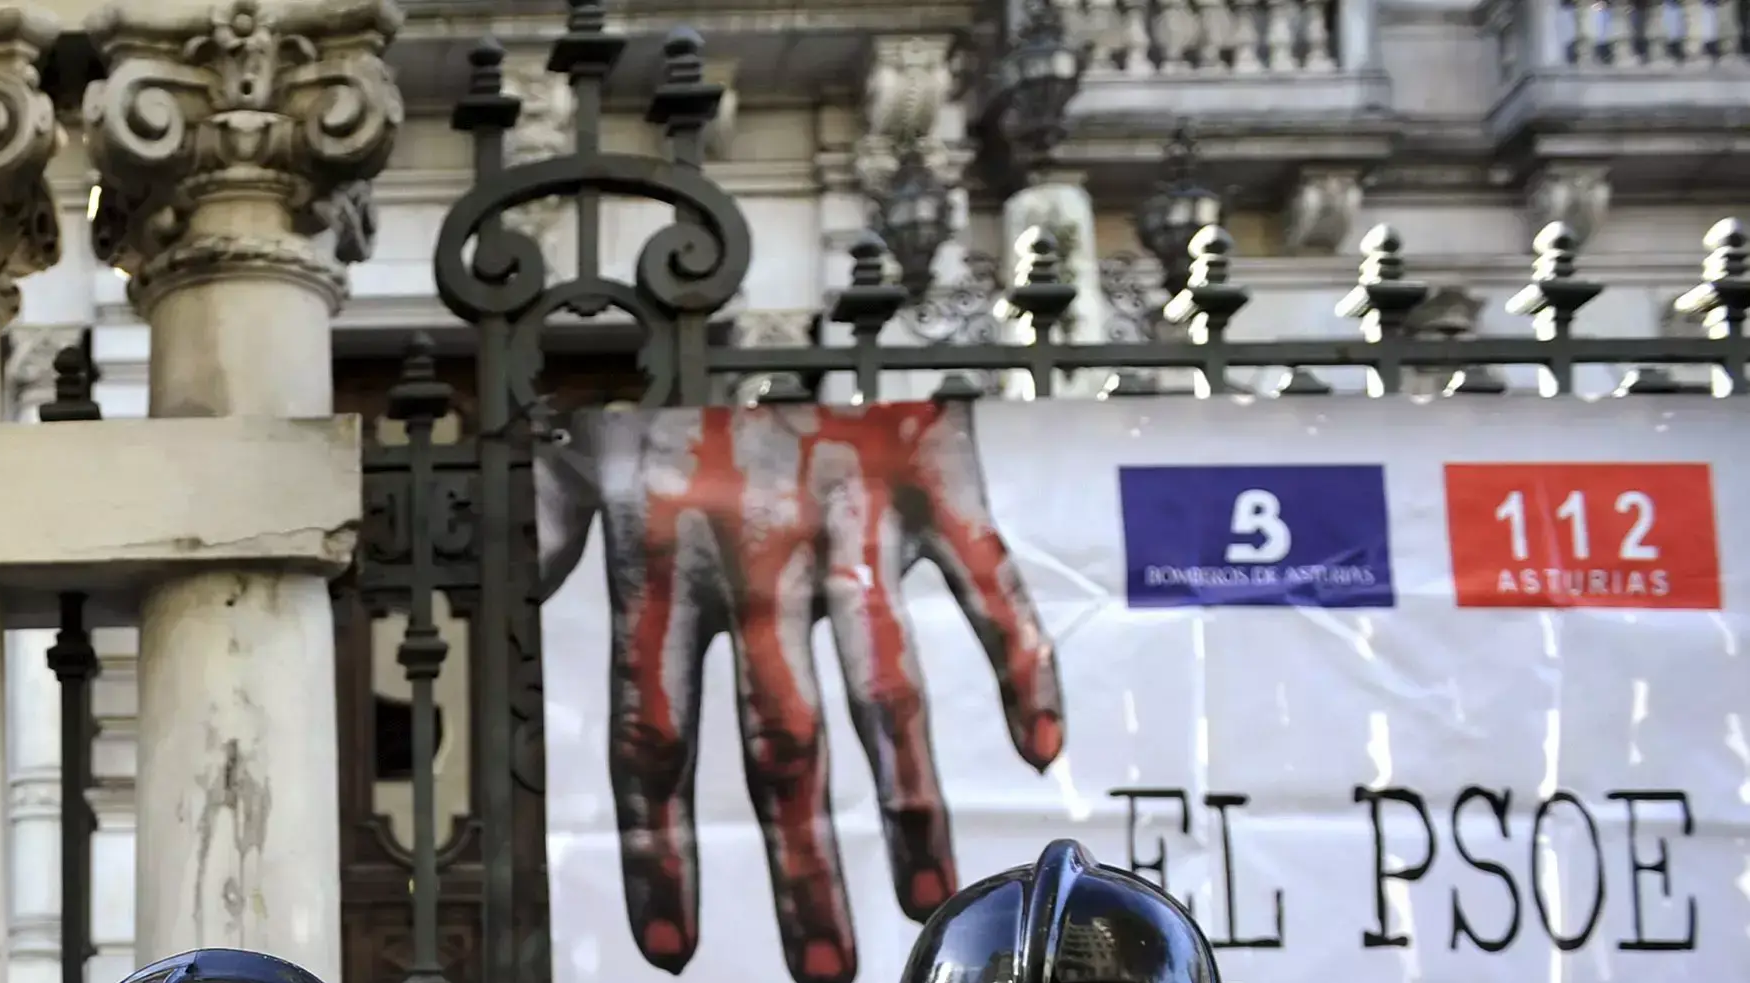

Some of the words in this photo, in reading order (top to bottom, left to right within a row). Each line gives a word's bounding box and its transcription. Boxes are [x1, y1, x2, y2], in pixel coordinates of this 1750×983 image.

[1495, 490, 1659, 561] 112
[1284, 564, 1376, 585] ASTURIAS
[1497, 568, 1670, 596] ASTURIAS
[1109, 787, 1283, 948] EL
[1354, 784, 1696, 952] PSOE
